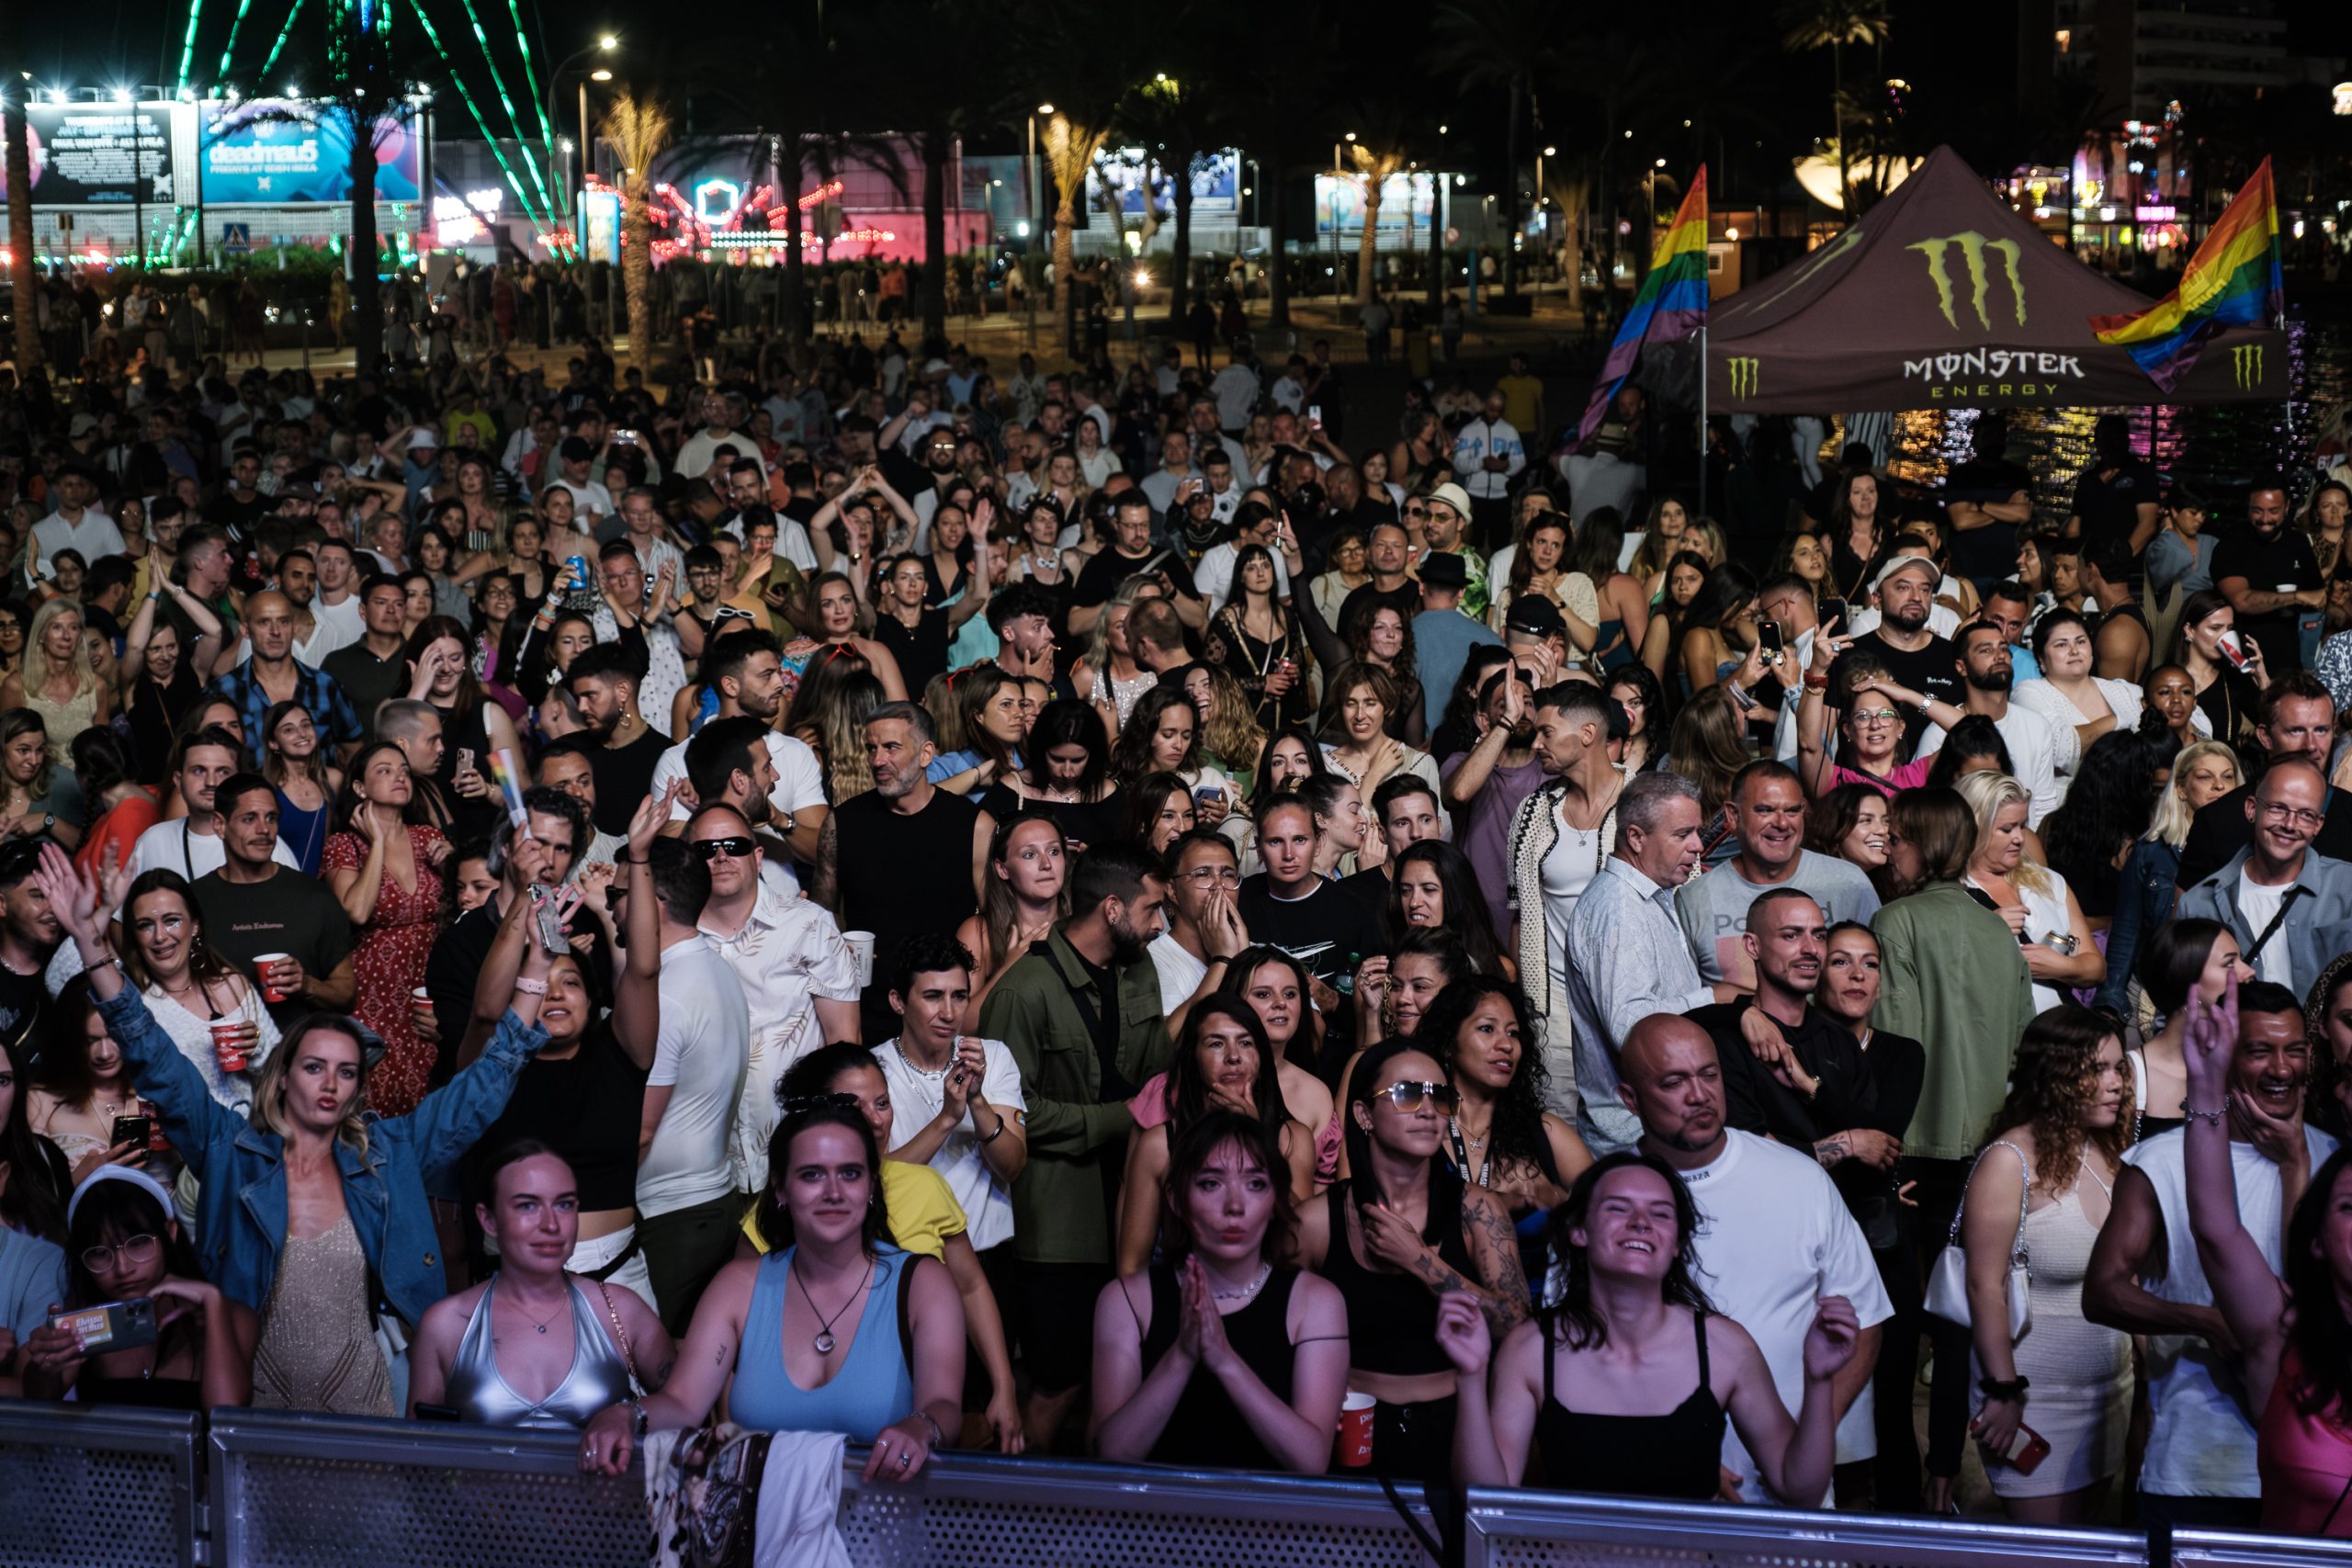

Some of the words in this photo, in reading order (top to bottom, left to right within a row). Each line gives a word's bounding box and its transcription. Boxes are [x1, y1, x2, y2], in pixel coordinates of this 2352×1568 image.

[209, 139, 319, 164] deadmau5
[1904, 347, 2086, 382] MONSTER
[1931, 384, 2058, 399] ENERGY
